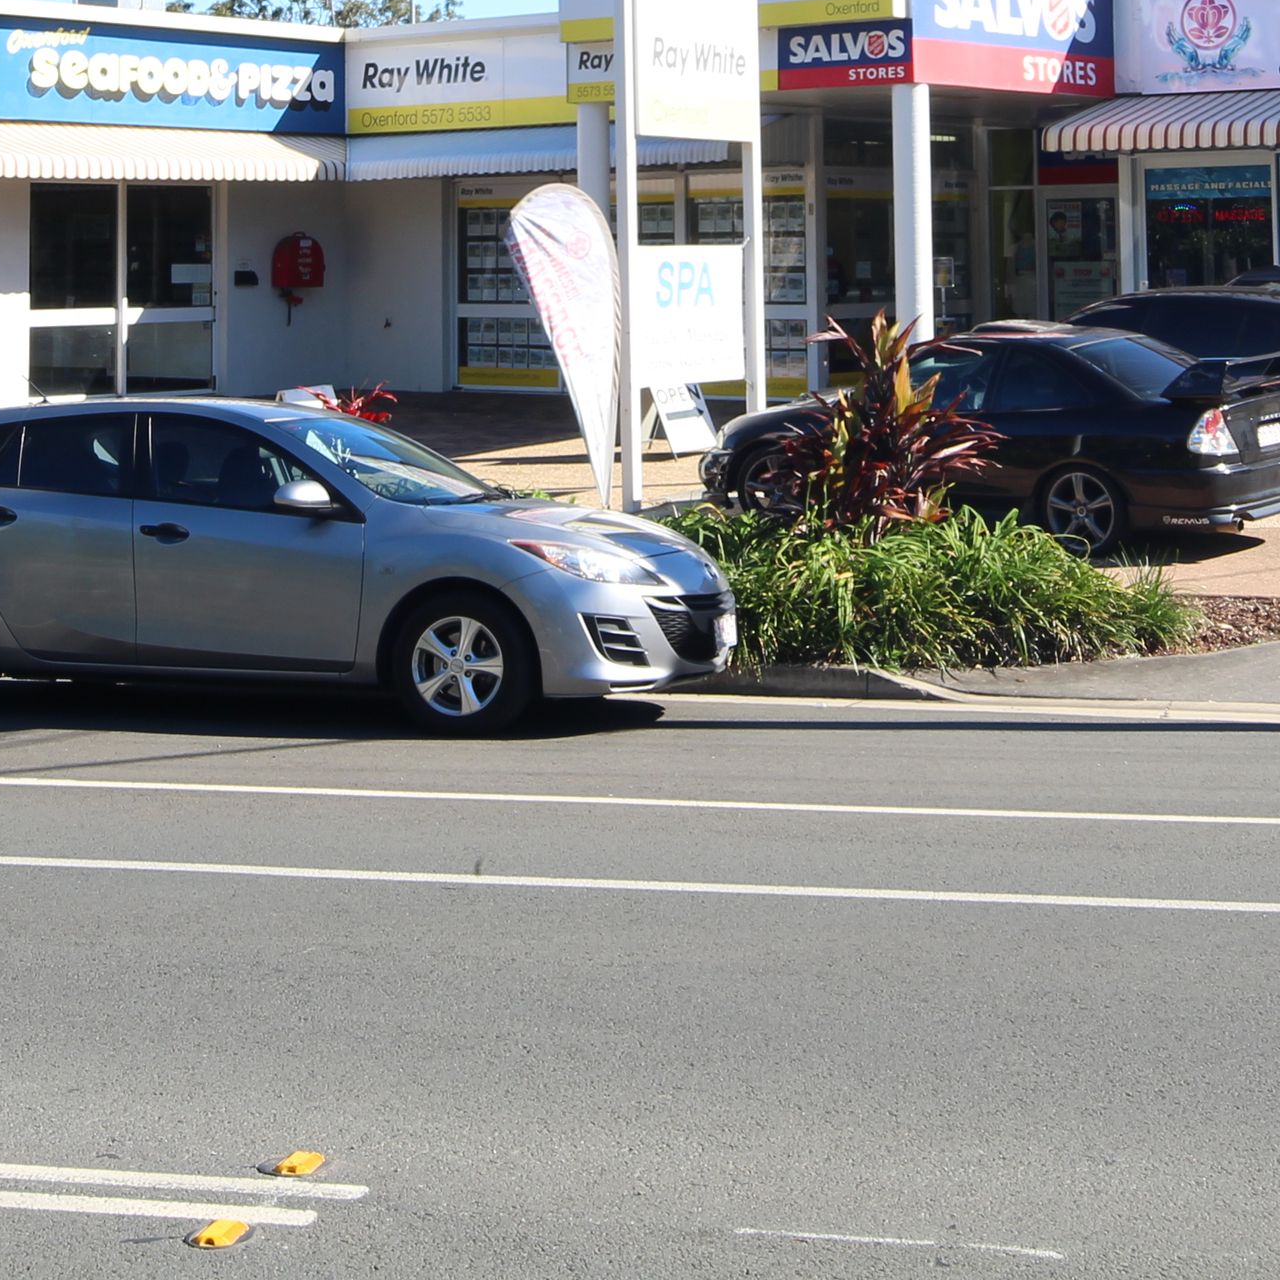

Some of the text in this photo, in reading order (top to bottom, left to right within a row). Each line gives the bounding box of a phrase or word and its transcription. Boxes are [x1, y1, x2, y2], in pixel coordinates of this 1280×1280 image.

[825, 0, 880, 16] Oxenford
[6, 27, 91, 54] Oxenford
[789, 29, 905, 64] SALVOS
[578, 51, 614, 72] Ray
[652, 36, 746, 77] Ray White
[362, 56, 486, 93] Ray White
[848, 66, 905, 80] STORES
[1023, 55, 1096, 86] STORES
[577, 84, 614, 98] 5573 55
[362, 106, 491, 128] Oxenford 5573 5533
[460, 187, 493, 196] Ray White
[1151, 181, 1272, 191] MASSAGE AND FACIALS
[656, 260, 716, 308] SPA
[656, 383, 700, 405] OPEN
